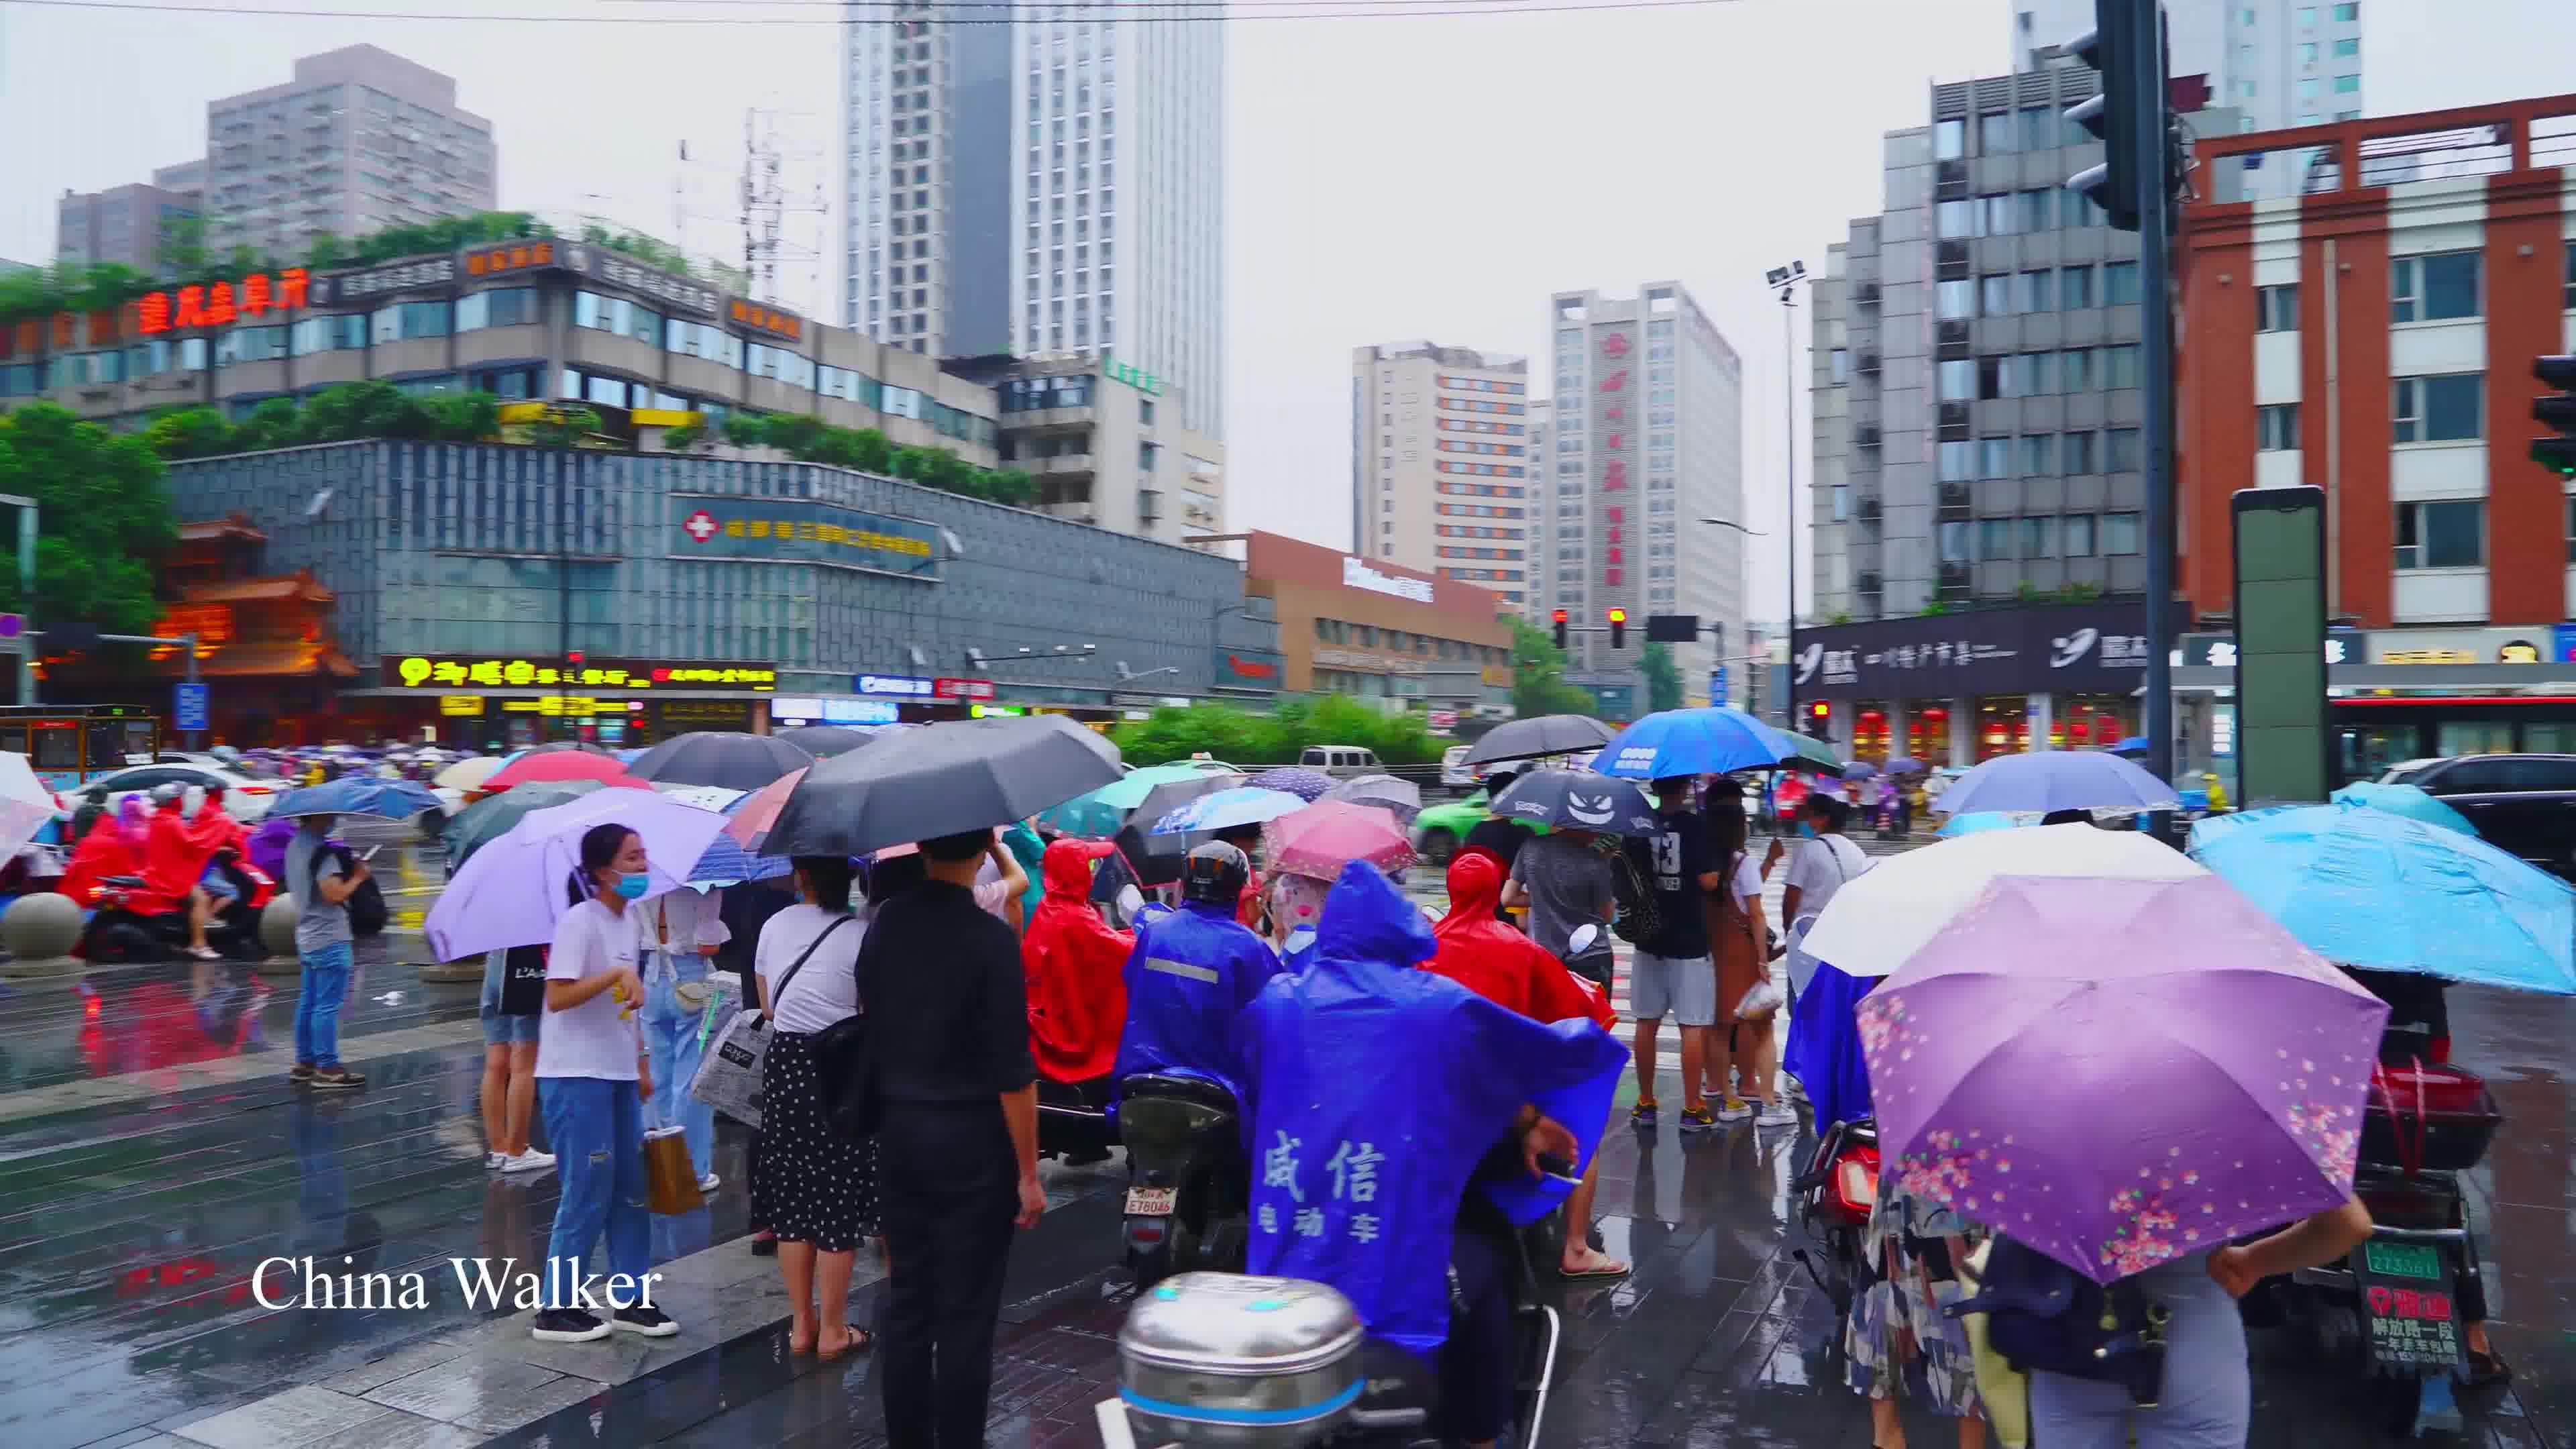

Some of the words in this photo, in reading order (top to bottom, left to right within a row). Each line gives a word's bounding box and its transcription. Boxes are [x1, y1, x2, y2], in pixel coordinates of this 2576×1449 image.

[1264, 1130, 1387, 1203] 威信
[1258, 1203, 1381, 1244] 电动车
[2372, 1317, 2455, 1340] 解放路一段
